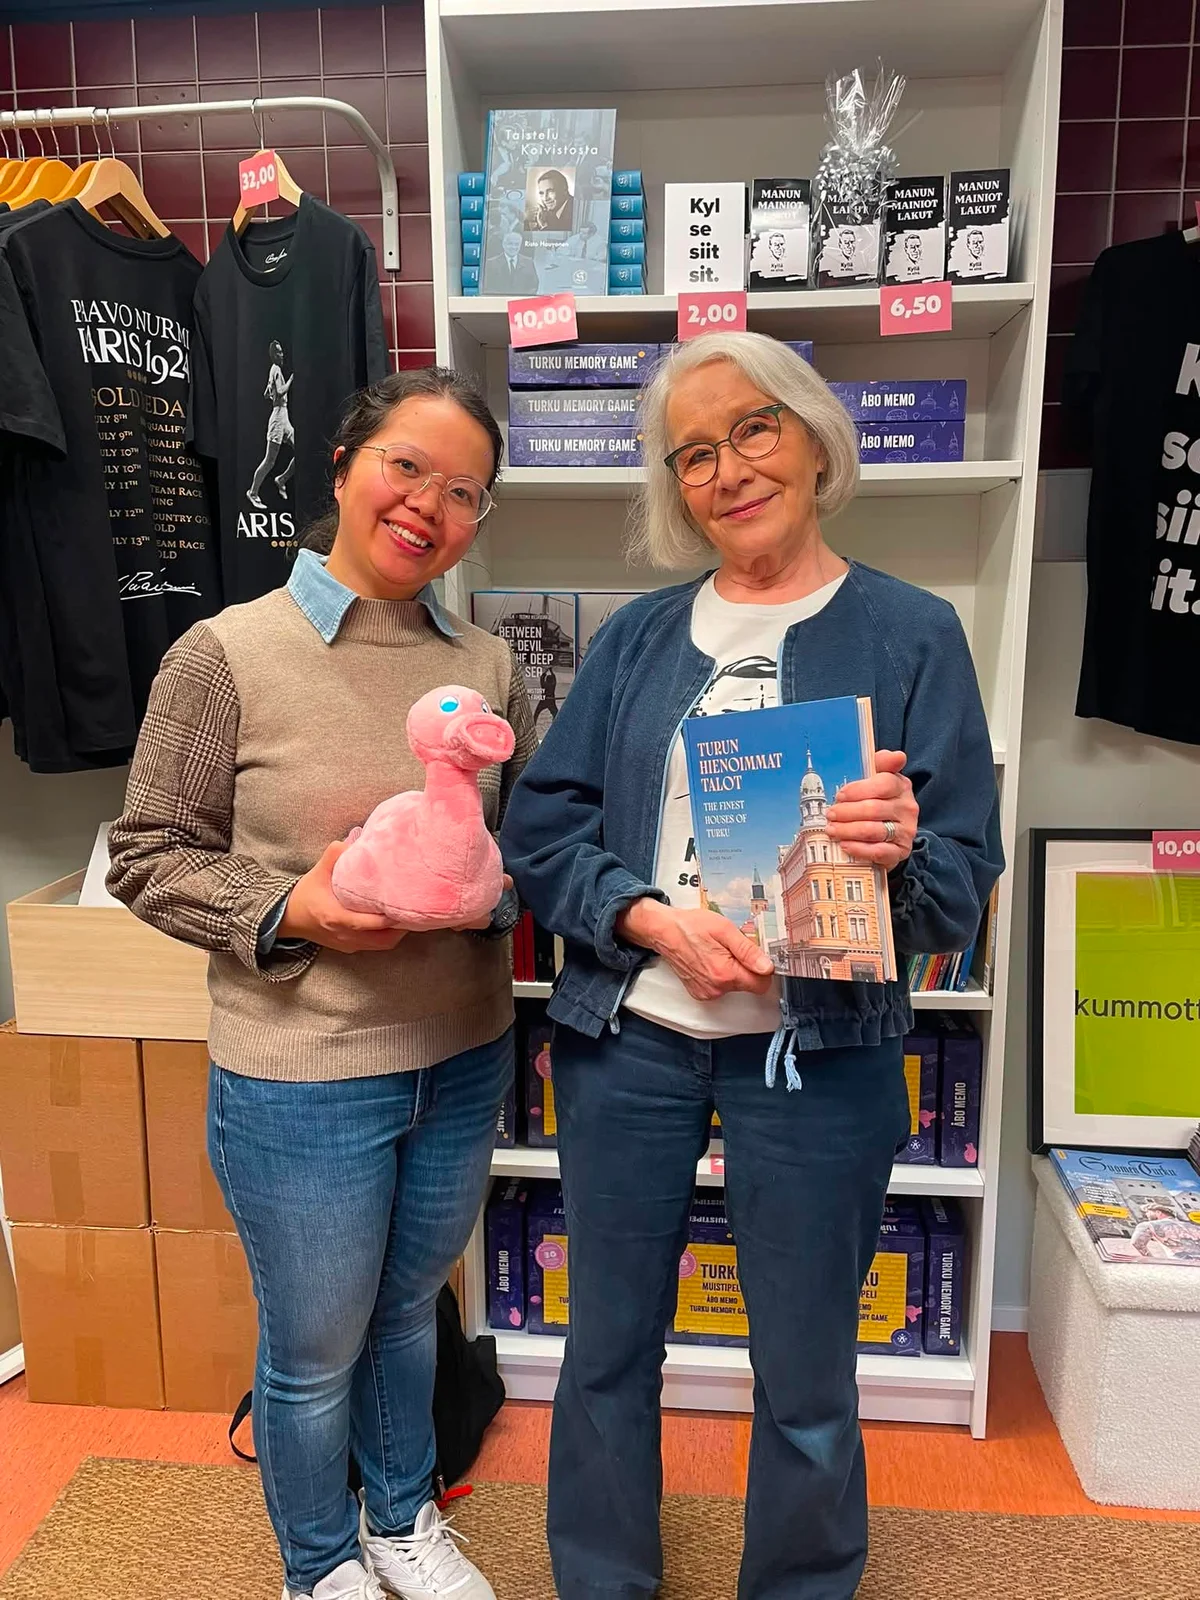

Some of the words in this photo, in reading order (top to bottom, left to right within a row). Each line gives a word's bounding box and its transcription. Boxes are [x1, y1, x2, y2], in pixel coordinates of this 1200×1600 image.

[505, 129, 559, 141] Taistelu
[521, 144, 598, 156] Koivistosta
[242, 164, 275, 191] 32,00
[958, 180, 1000, 191] MANUN
[761, 189, 801, 199] MANUN
[895, 188, 935, 199] MANUN
[955, 192, 1003, 204] MAINIOT
[690, 198, 720, 214] Kyl
[758, 201, 804, 210] MAINIOT
[891, 199, 938, 211] MAINIOT
[960, 205, 997, 215] LAKUT
[897, 210, 933, 221] LAKUT
[690, 224, 711, 237] se
[689, 243, 719, 259] siit
[689, 266, 719, 283] sit.
[890, 295, 941, 318] 6,50
[514, 305, 572, 329] 10,00
[687, 304, 738, 326] 2,00
[528, 356, 562, 369] TURKU
[564, 356, 606, 369] MEMORY
[609, 355, 638, 369] GAME
[528, 400, 560, 412] TURKU
[563, 399, 605, 412] MEMORY
[608, 399, 635, 412] GAME
[861, 391, 881, 407] ÅBO
[884, 393, 915, 406] MEMO
[98, 432, 115, 440] ULY
[860, 432, 881, 449] ÅBO
[883, 434, 914, 448] MEMO
[528, 439, 561, 452] TURKU
[564, 439, 606, 452] MEMORY
[608, 438, 636, 451] GAME
[101, 449, 117, 457] ULY
[153, 513, 192, 523] OUNTRY
[237, 512, 295, 538] ARIS
[179, 540, 205, 550] RACE
[1150, 558, 1200, 615] it.
[499, 626, 542, 639] BETWEEN
[517, 640, 544, 652] DEVIL
[530, 653, 554, 665] DEEP
[525, 666, 543, 678] SEA
[697, 738, 739, 757] TURUN
[699, 753, 783, 775] HIENOIMMAT
[701, 775, 742, 793] TALOT
[703, 802, 718, 811] THE
[719, 800, 745, 810] FINEST
[704, 815, 735, 825] HOUSES
[735, 813, 747, 824] OF
[706, 828, 730, 838] TURKU
[955, 1082, 967, 1109] MEMO
[951, 1110, 966, 1127] ÅBO
[498, 1250, 509, 1275] MEMO
[941, 1252, 953, 1280] TURKU
[700, 1264, 738, 1280] TURK
[496, 1276, 510, 1292] ÅBO
[702, 1282, 740, 1293] MUISTIPEL
[940, 1281, 953, 1317] MEMORY
[711, 1306, 736, 1314] MEMORY
[871, 1314, 889, 1322] GAME
[939, 1317, 951, 1340] GAME
